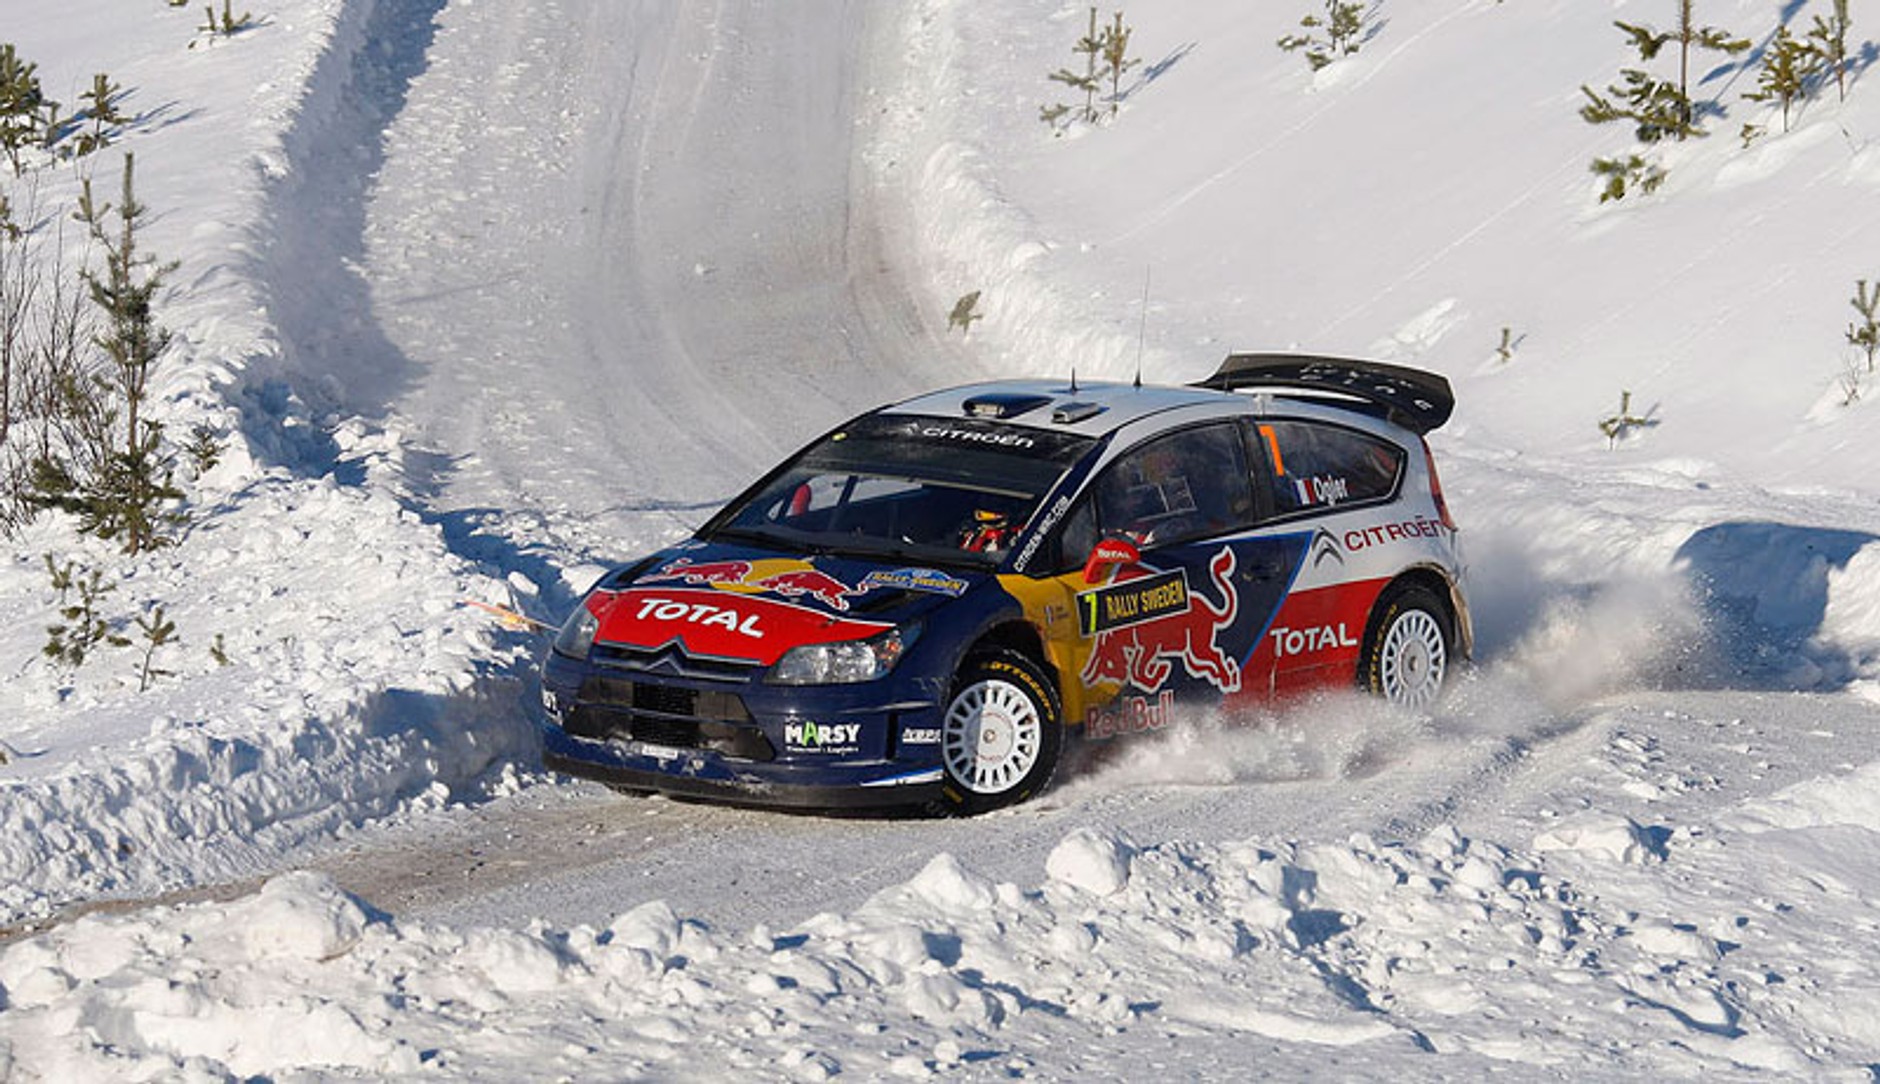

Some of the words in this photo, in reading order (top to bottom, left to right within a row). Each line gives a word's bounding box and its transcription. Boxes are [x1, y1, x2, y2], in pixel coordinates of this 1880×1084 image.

[1097, 547, 1132, 560] TOTAL
[636, 598, 765, 638] TOTAL
[1084, 591, 1097, 634] 7
[1105, 594, 1139, 621] RALLY
[1141, 580, 1185, 613] SWEDEN
[1269, 622, 1358, 658] TOTAL
[1085, 696, 1131, 739] Red
[1131, 689, 1174, 732] Bull
[784, 721, 861, 747] MARSY
